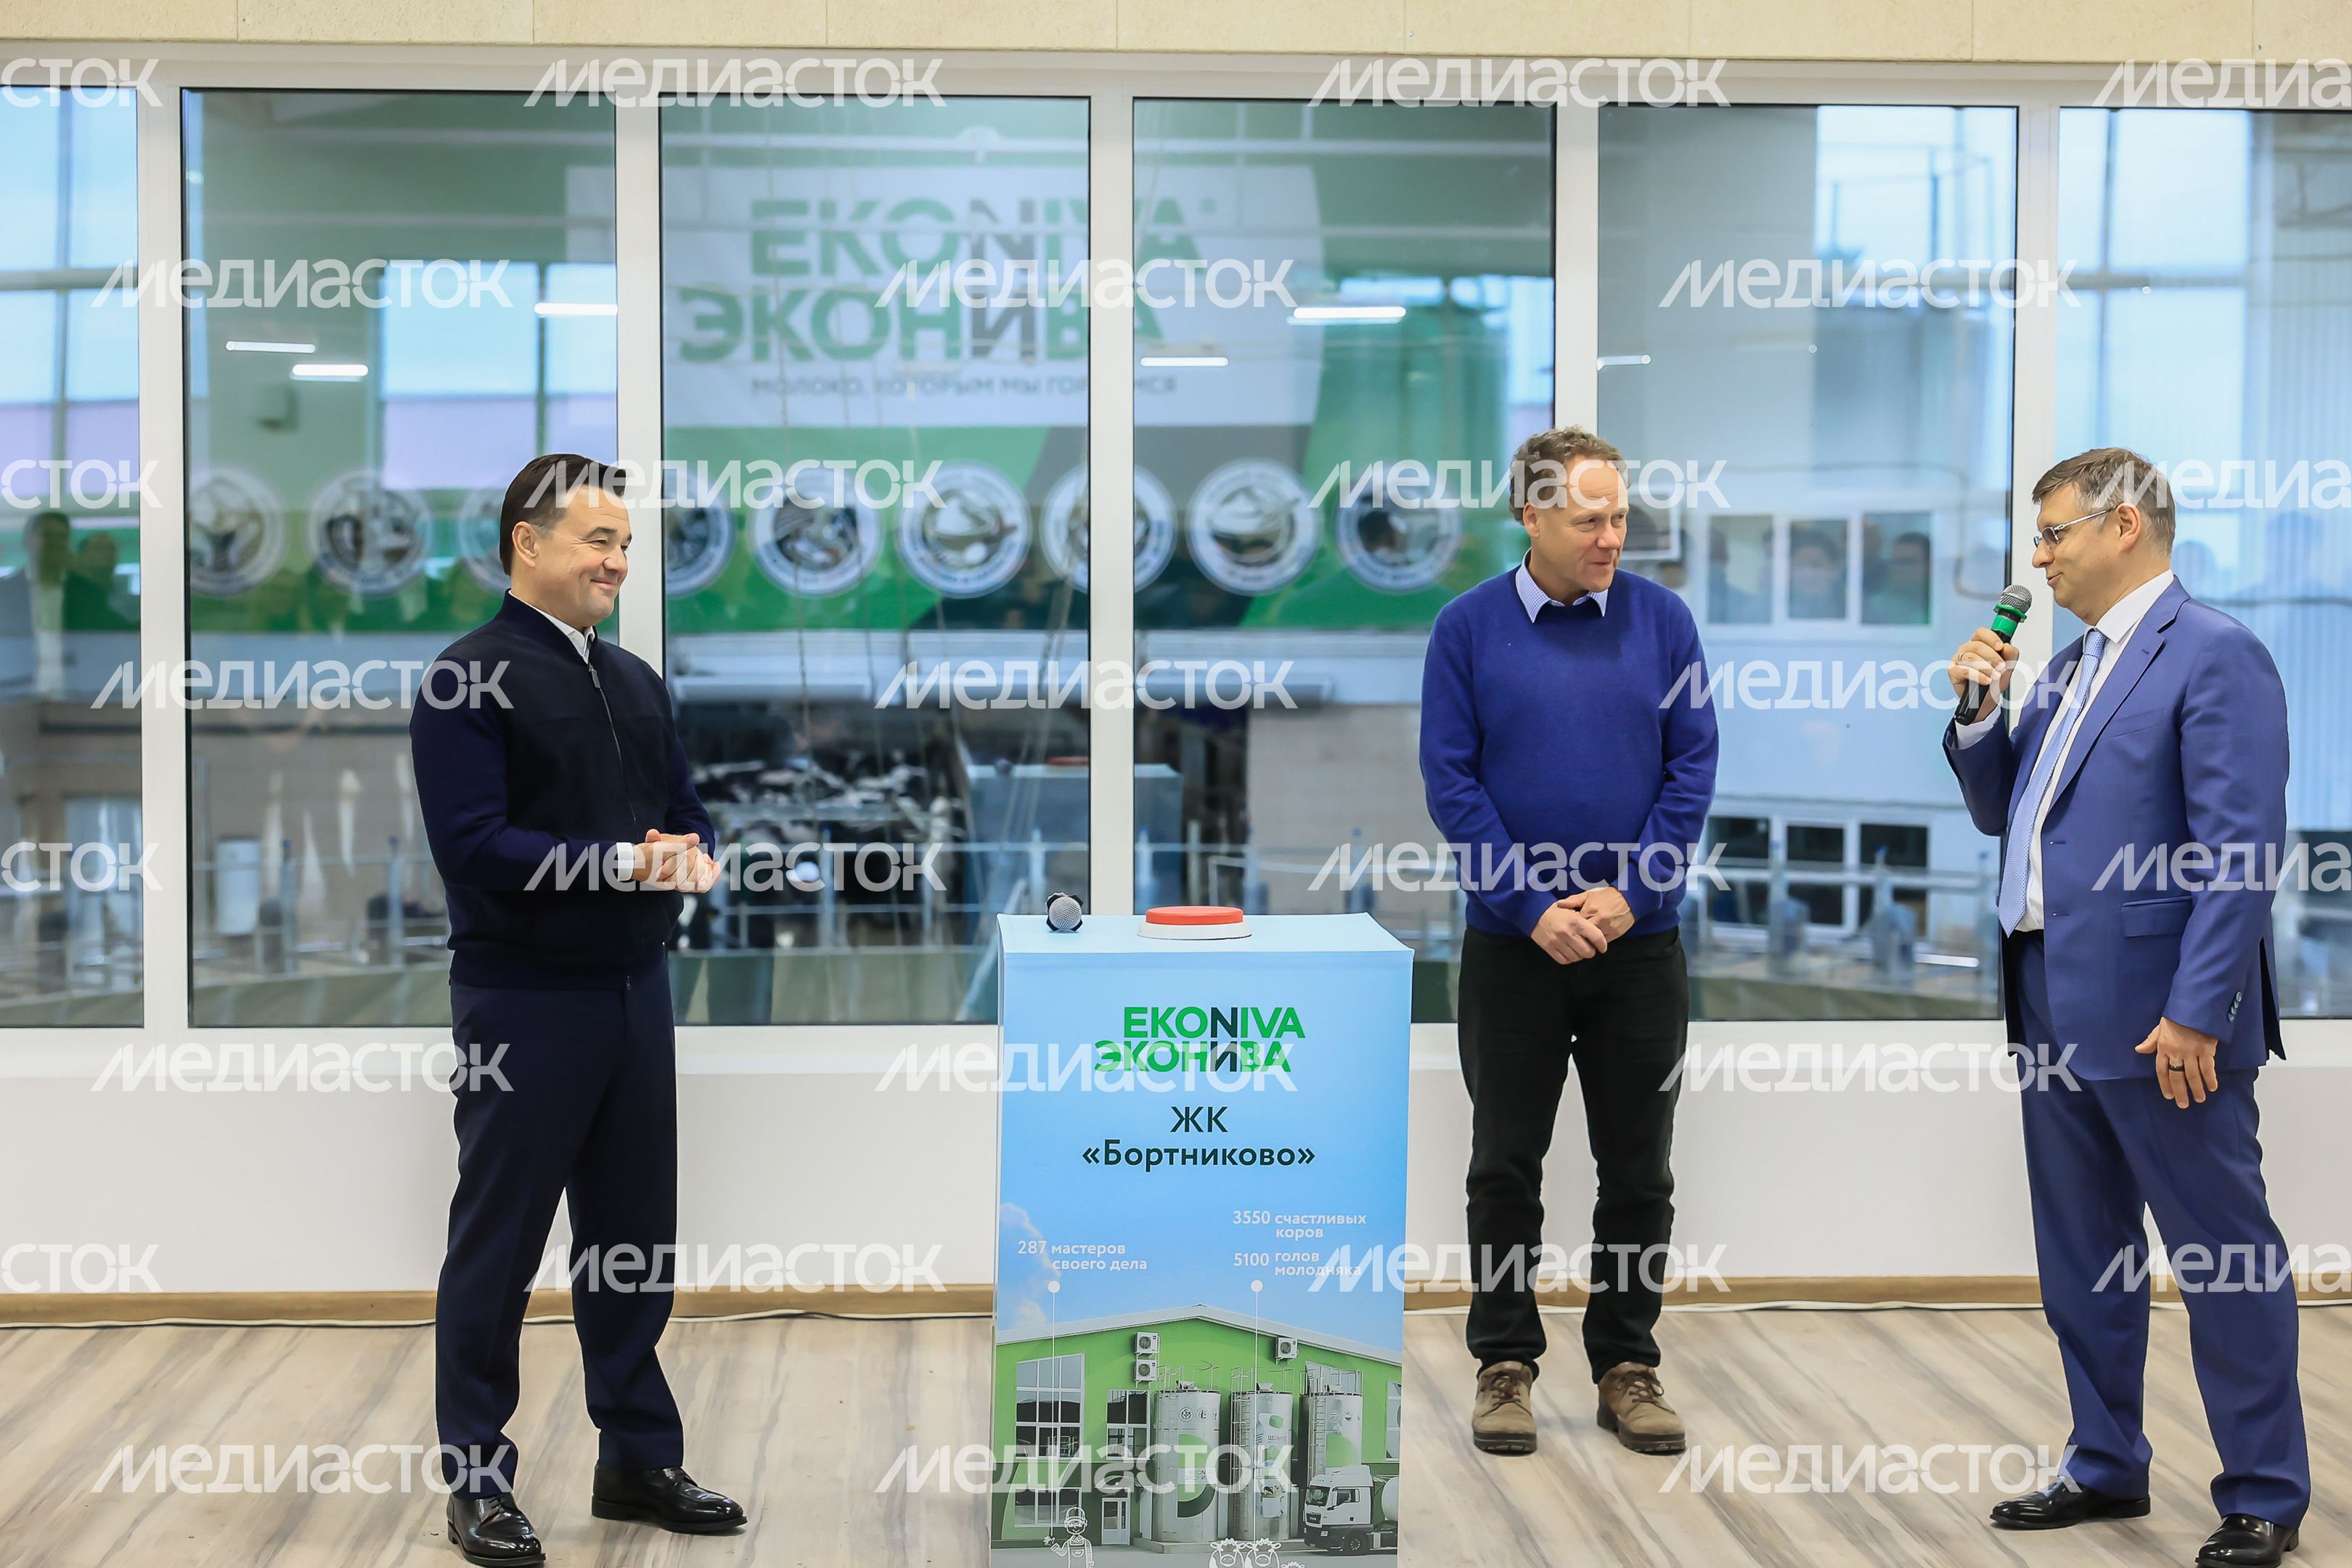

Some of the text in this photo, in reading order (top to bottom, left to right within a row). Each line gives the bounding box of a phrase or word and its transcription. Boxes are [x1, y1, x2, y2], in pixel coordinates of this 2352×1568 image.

[1124, 1007, 1306, 1038] EKONIVA
[1094, 1040, 1291, 1072] ЭКОНИВА
[1169, 1106, 1228, 1132] ЖК
[1082, 1139, 1315, 1172] «Бортниково»
[1233, 1210, 1366, 1225] 3550 счастливых
[1276, 1229, 1323, 1241] коров
[1018, 1240, 1126, 1257] 287 мастеров
[1053, 1260, 1147, 1271] своего дела
[1234, 1252, 1319, 1267] 5100 голов
[1275, 1266, 1362, 1278] молодняка
